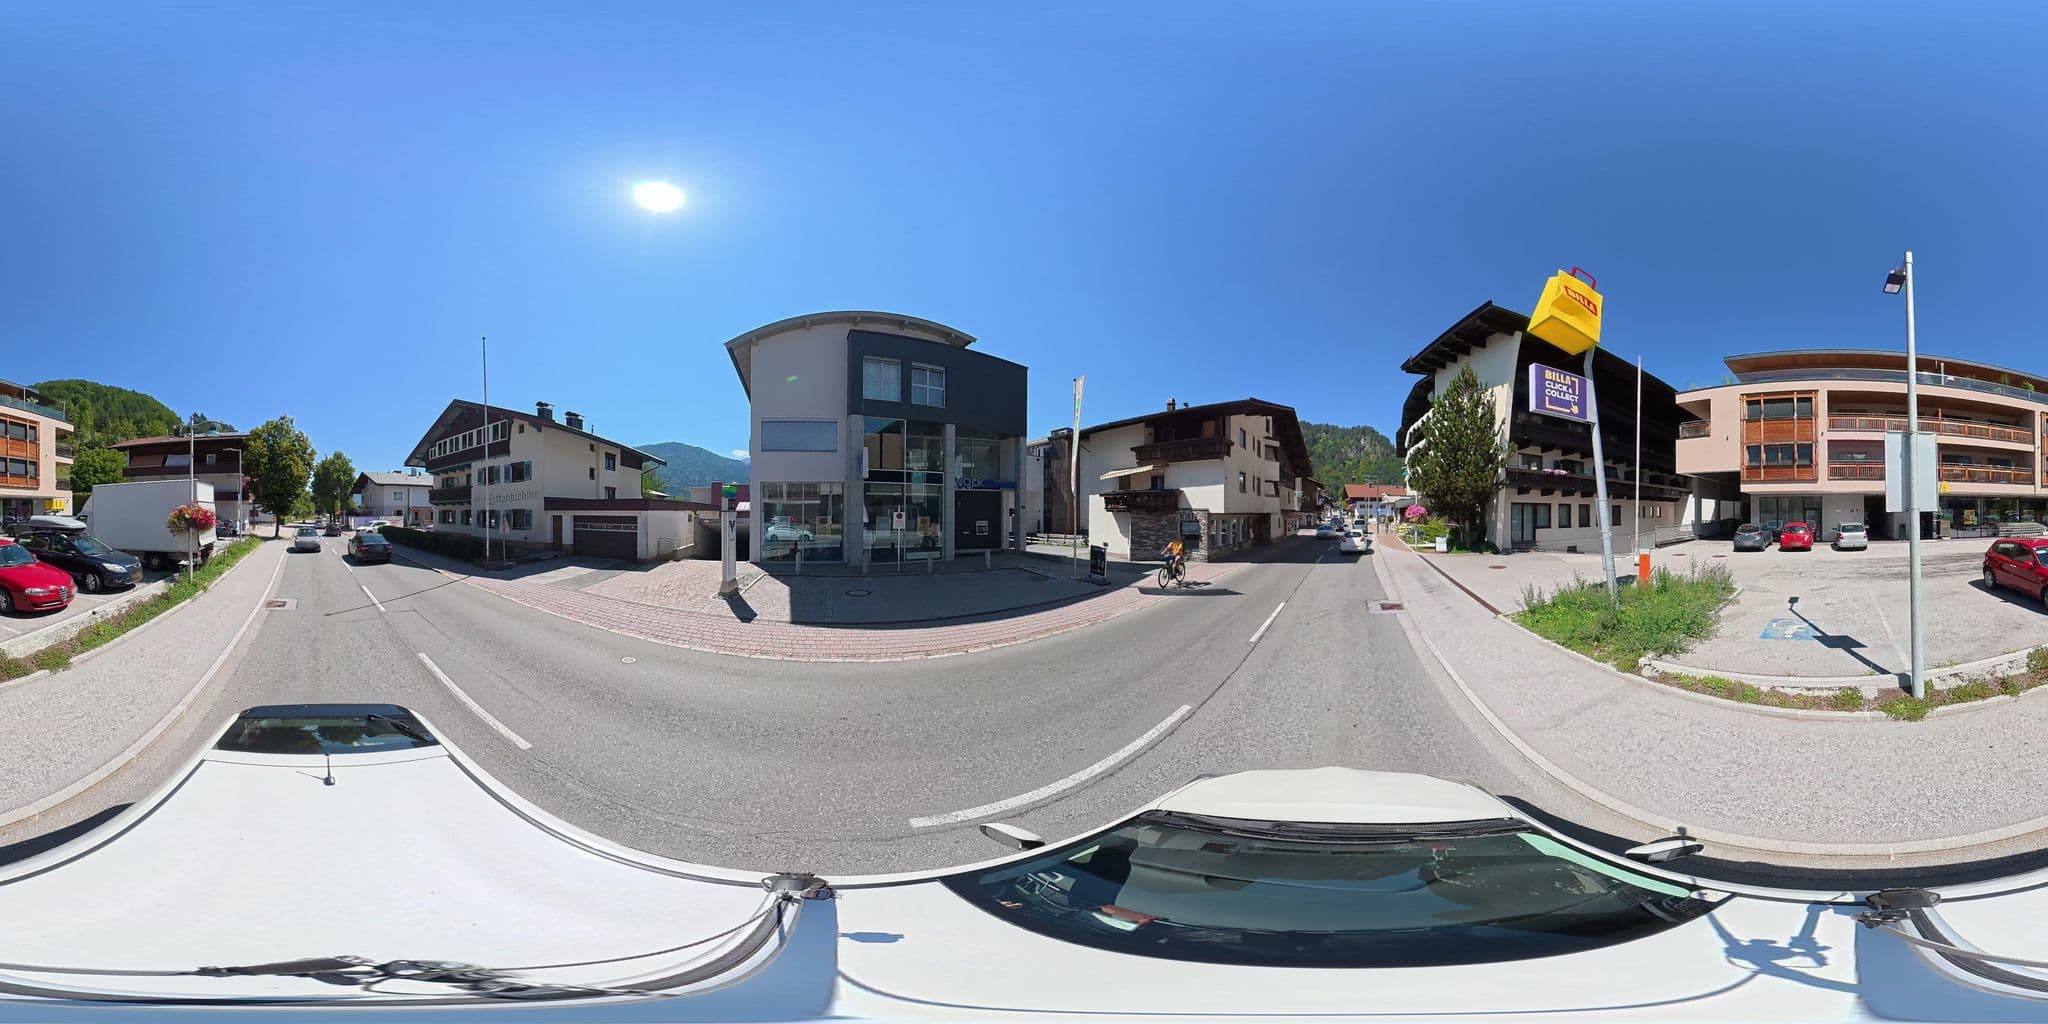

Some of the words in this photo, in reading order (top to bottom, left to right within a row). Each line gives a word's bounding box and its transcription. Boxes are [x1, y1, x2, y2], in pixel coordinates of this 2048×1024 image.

[1566, 288, 1596, 313] BILLA
[1545, 370, 1571, 385] BILLA
[1545, 381, 1568, 393] CLICK
[1546, 389, 1579, 402] COLLECT
